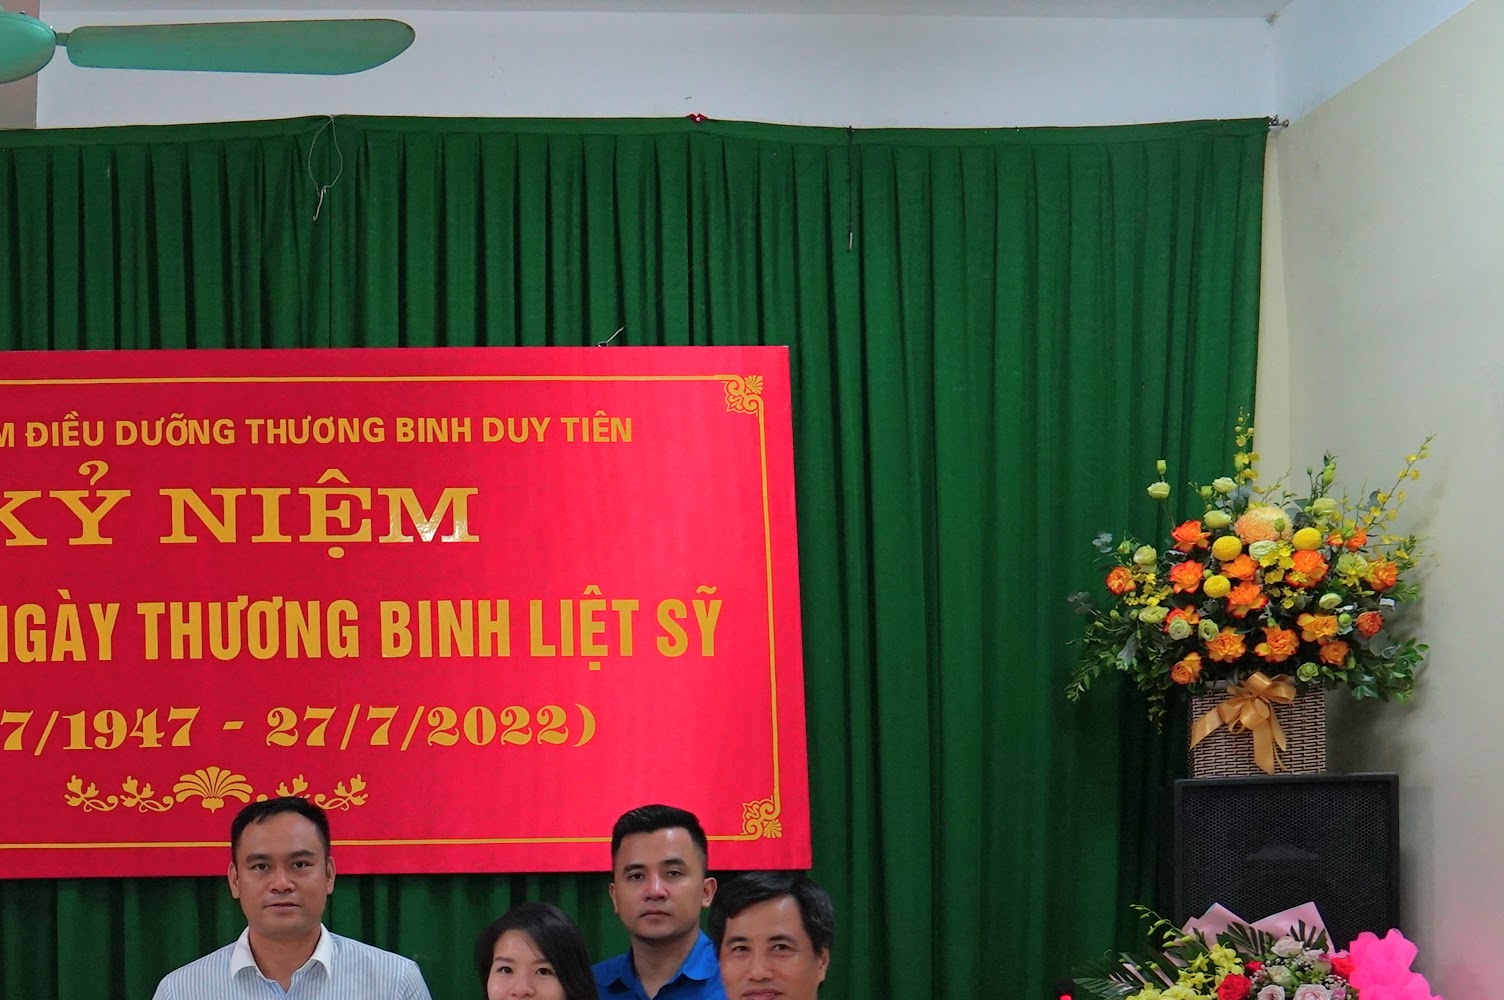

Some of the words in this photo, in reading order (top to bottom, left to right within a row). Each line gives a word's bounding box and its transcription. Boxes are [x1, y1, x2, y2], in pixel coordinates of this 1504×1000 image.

[25, 410, 105, 448] ĐIỀU
[116, 413, 236, 447] DƯỠNG
[245, 415, 385, 445] THƯƠNG
[396, 417, 472, 443] BINH
[483, 417, 551, 443] DUY
[561, 410, 633, 443] TIÊN
[159, 468, 480, 559] NIỆM
[137, 595, 360, 661] THƯƠNG
[380, 599, 511, 659] BINH
[529, 585, 639, 670] LIỆT
[656, 585, 723, 658] SỸ
[266, 703, 597, 751] 27/7/2022)
